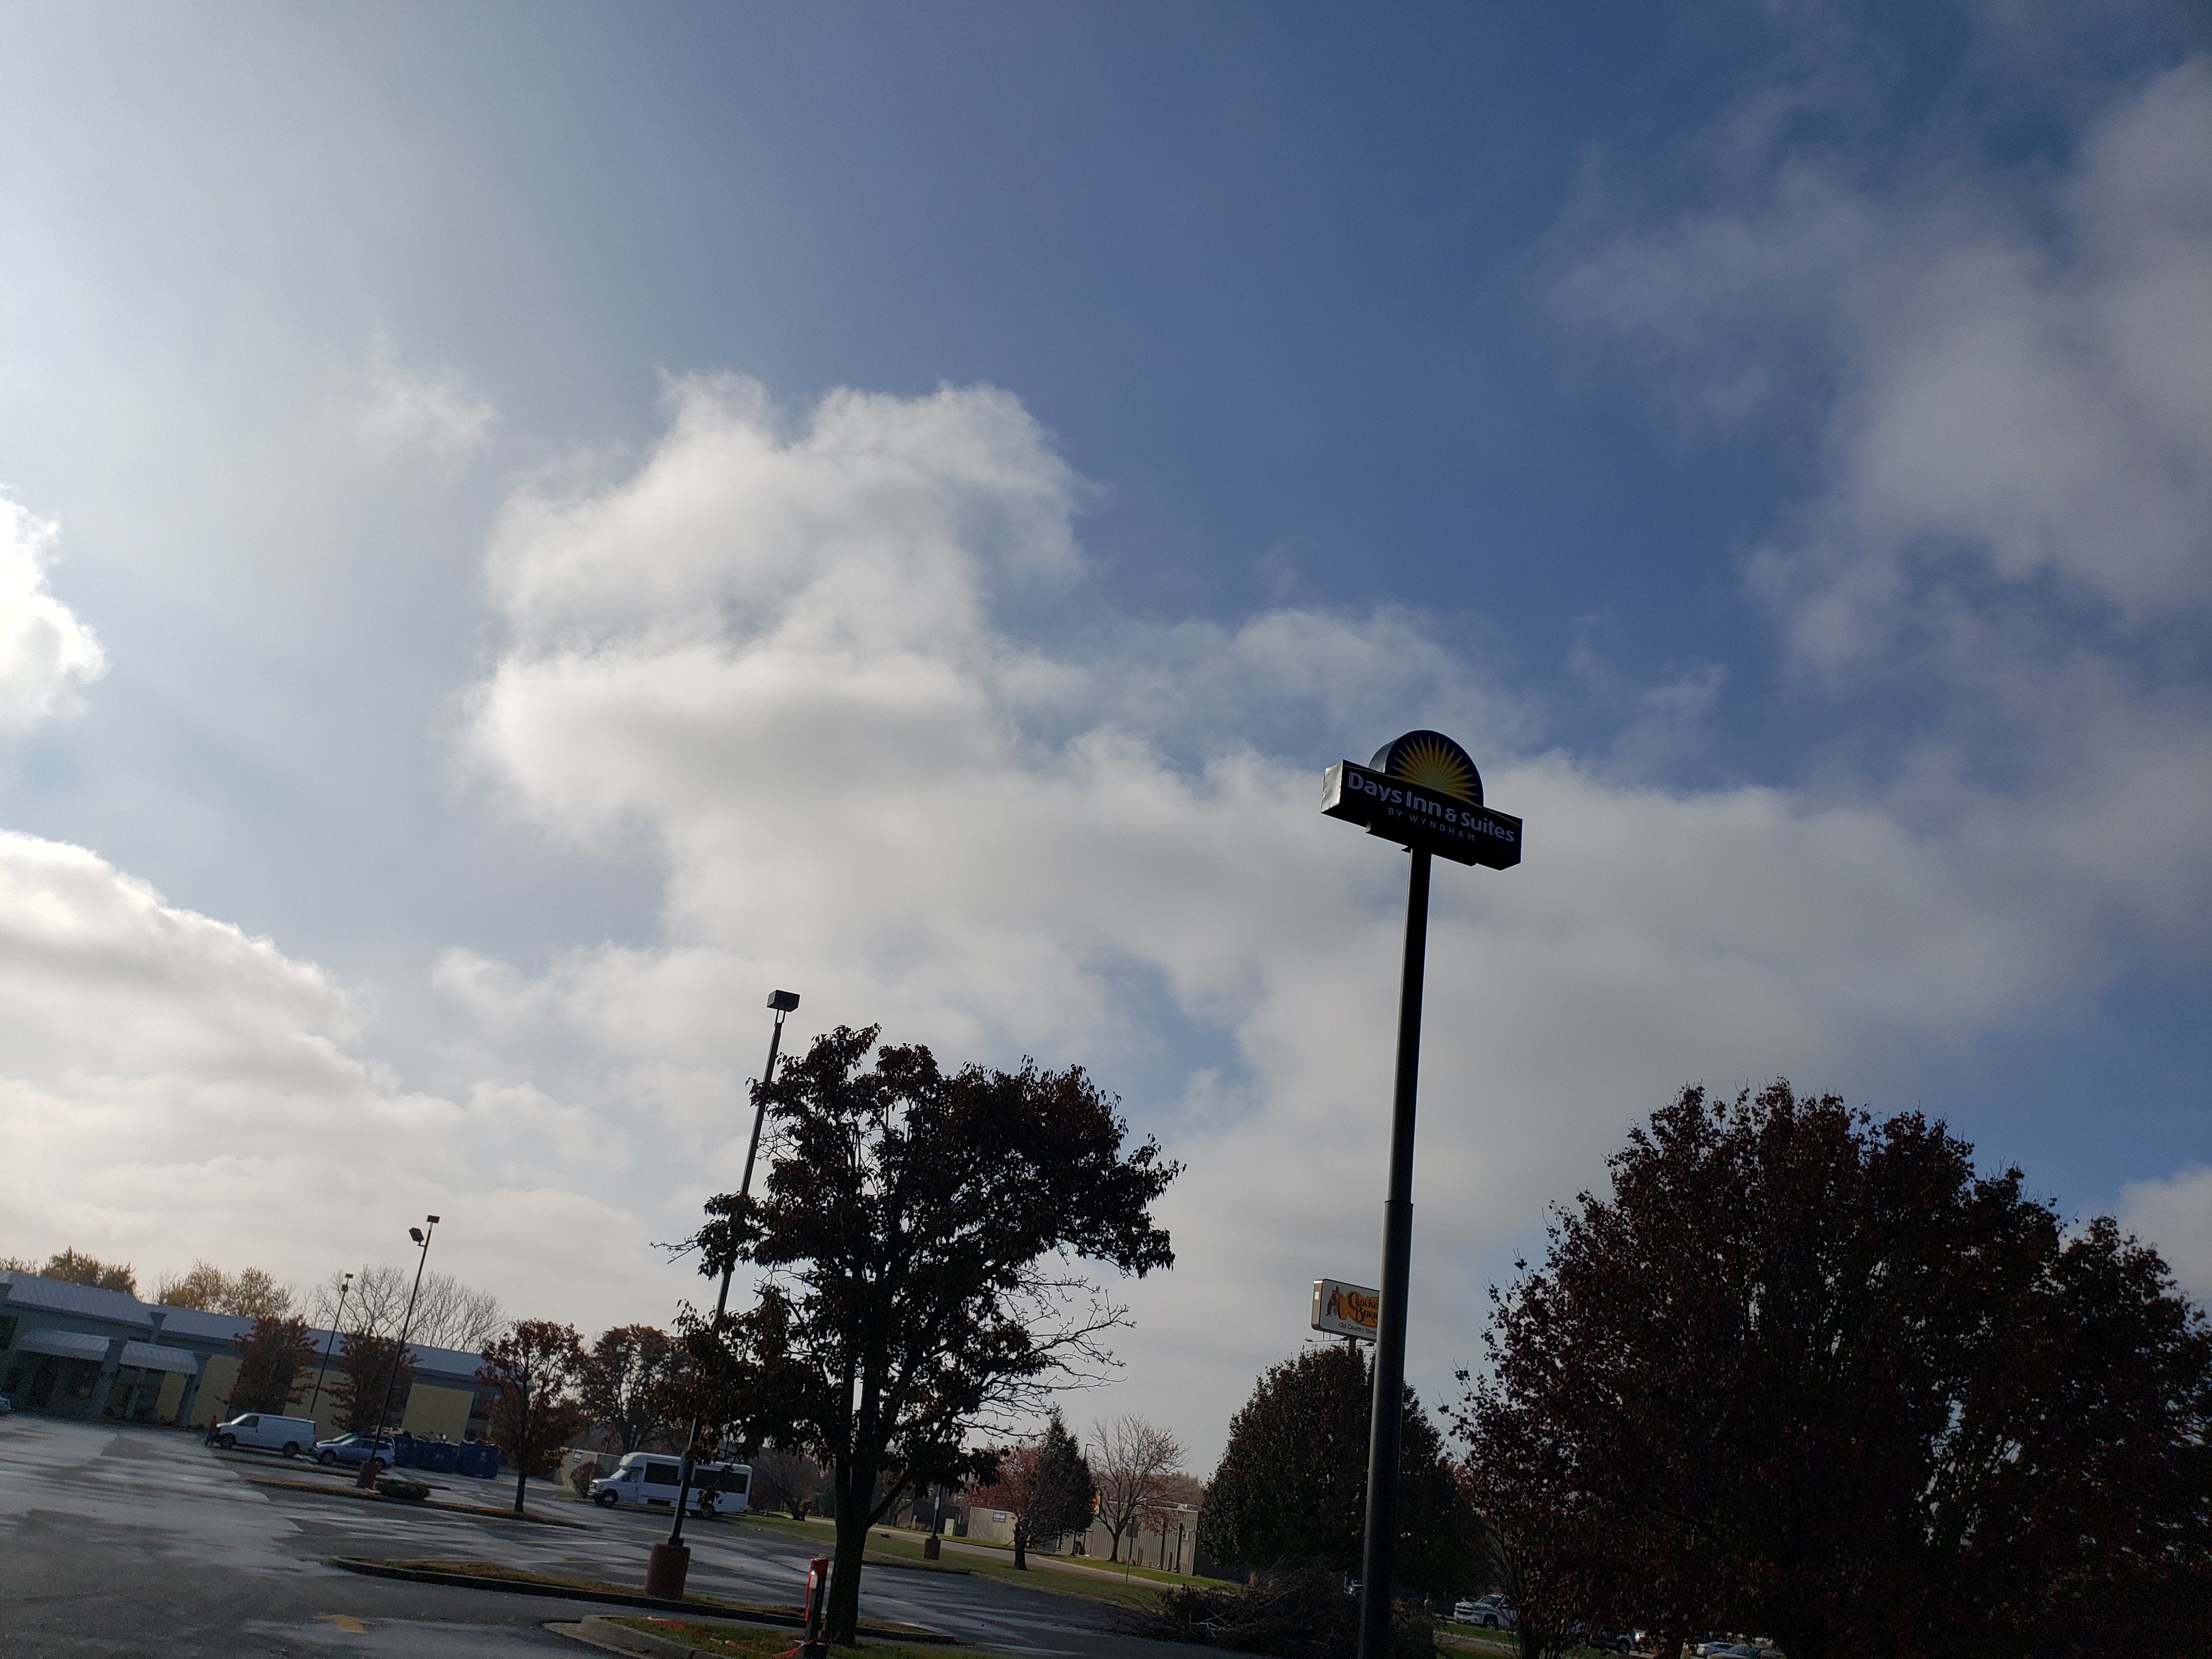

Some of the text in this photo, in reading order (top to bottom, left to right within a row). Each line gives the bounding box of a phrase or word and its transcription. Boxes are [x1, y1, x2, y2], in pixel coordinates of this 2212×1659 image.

[1348, 771, 1514, 842] Days Inn & Suites
[1388, 807, 1475, 842] BY WYNDHAM
[1348, 1291, 1379, 1310] Cracke
[1347, 1324, 1364, 1333] Country
